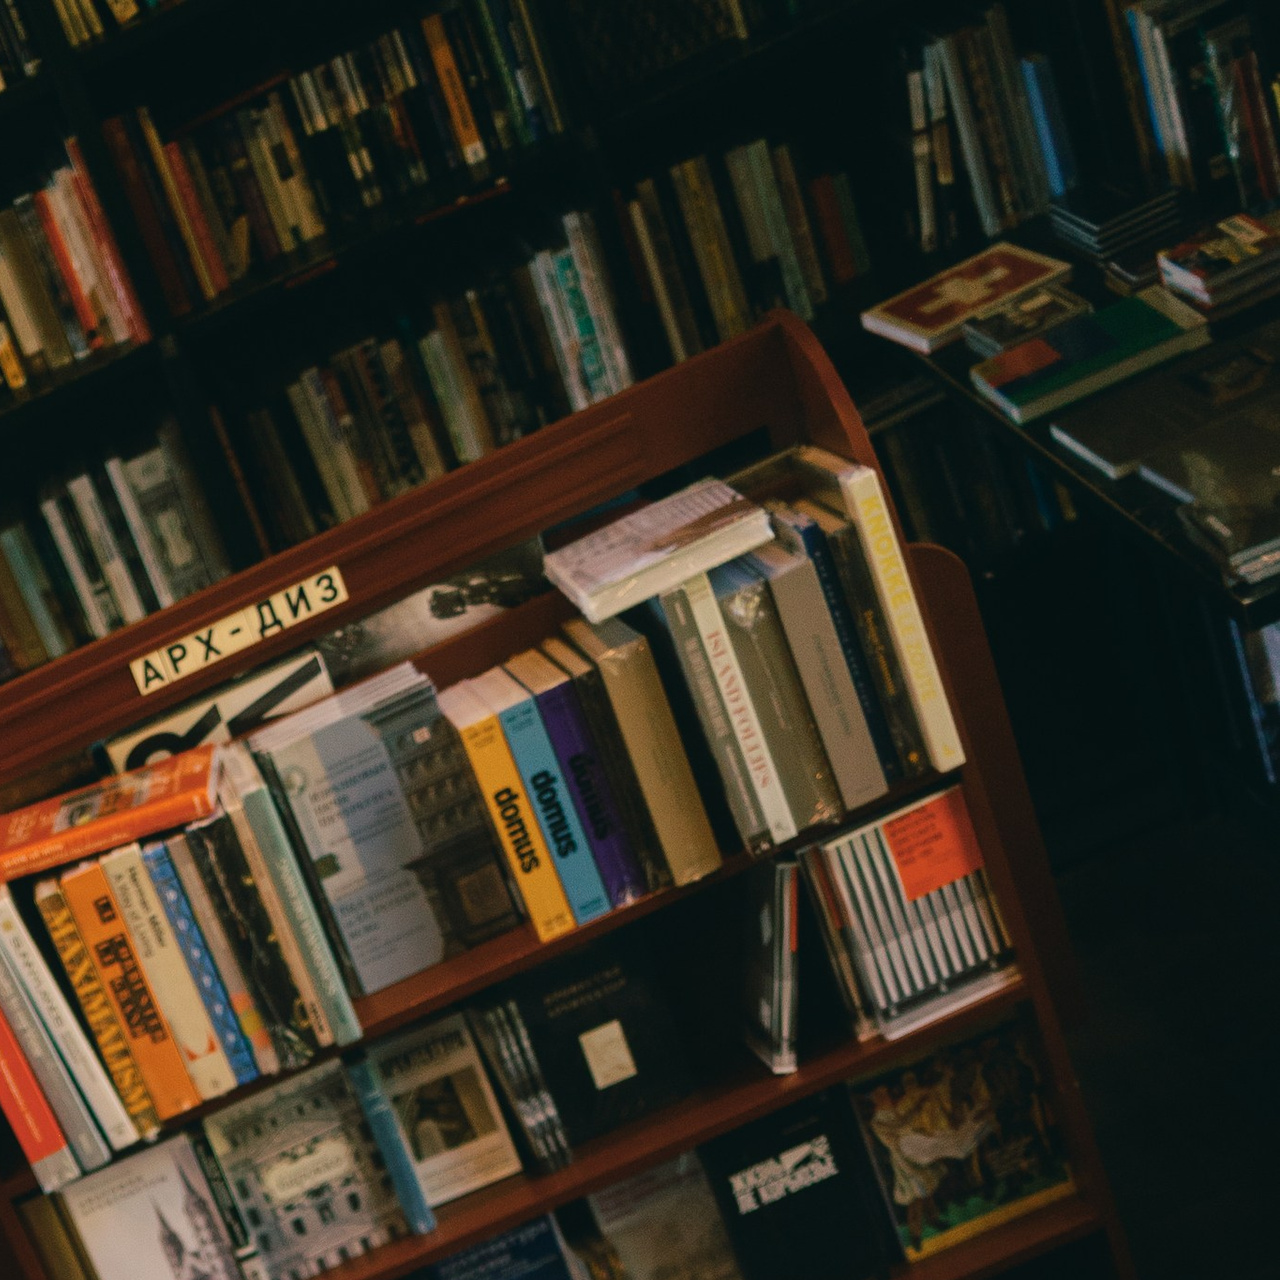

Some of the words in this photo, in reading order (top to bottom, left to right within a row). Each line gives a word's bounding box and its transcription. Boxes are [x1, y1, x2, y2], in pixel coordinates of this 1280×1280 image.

[858, 494, 911, 606] KNOKKE
[139, 573, 341, 690] АРХ-ДИЗ
[704, 629, 744, 703] ISLAND
[731, 704, 774, 788] FOLLIES
[492, 785, 543, 874] domus
[529, 767, 580, 859] domus
[568, 749, 618, 841] domus
[146, 913, 168, 948] Miller
[44, 907, 153, 1116] MAXIMALISM
